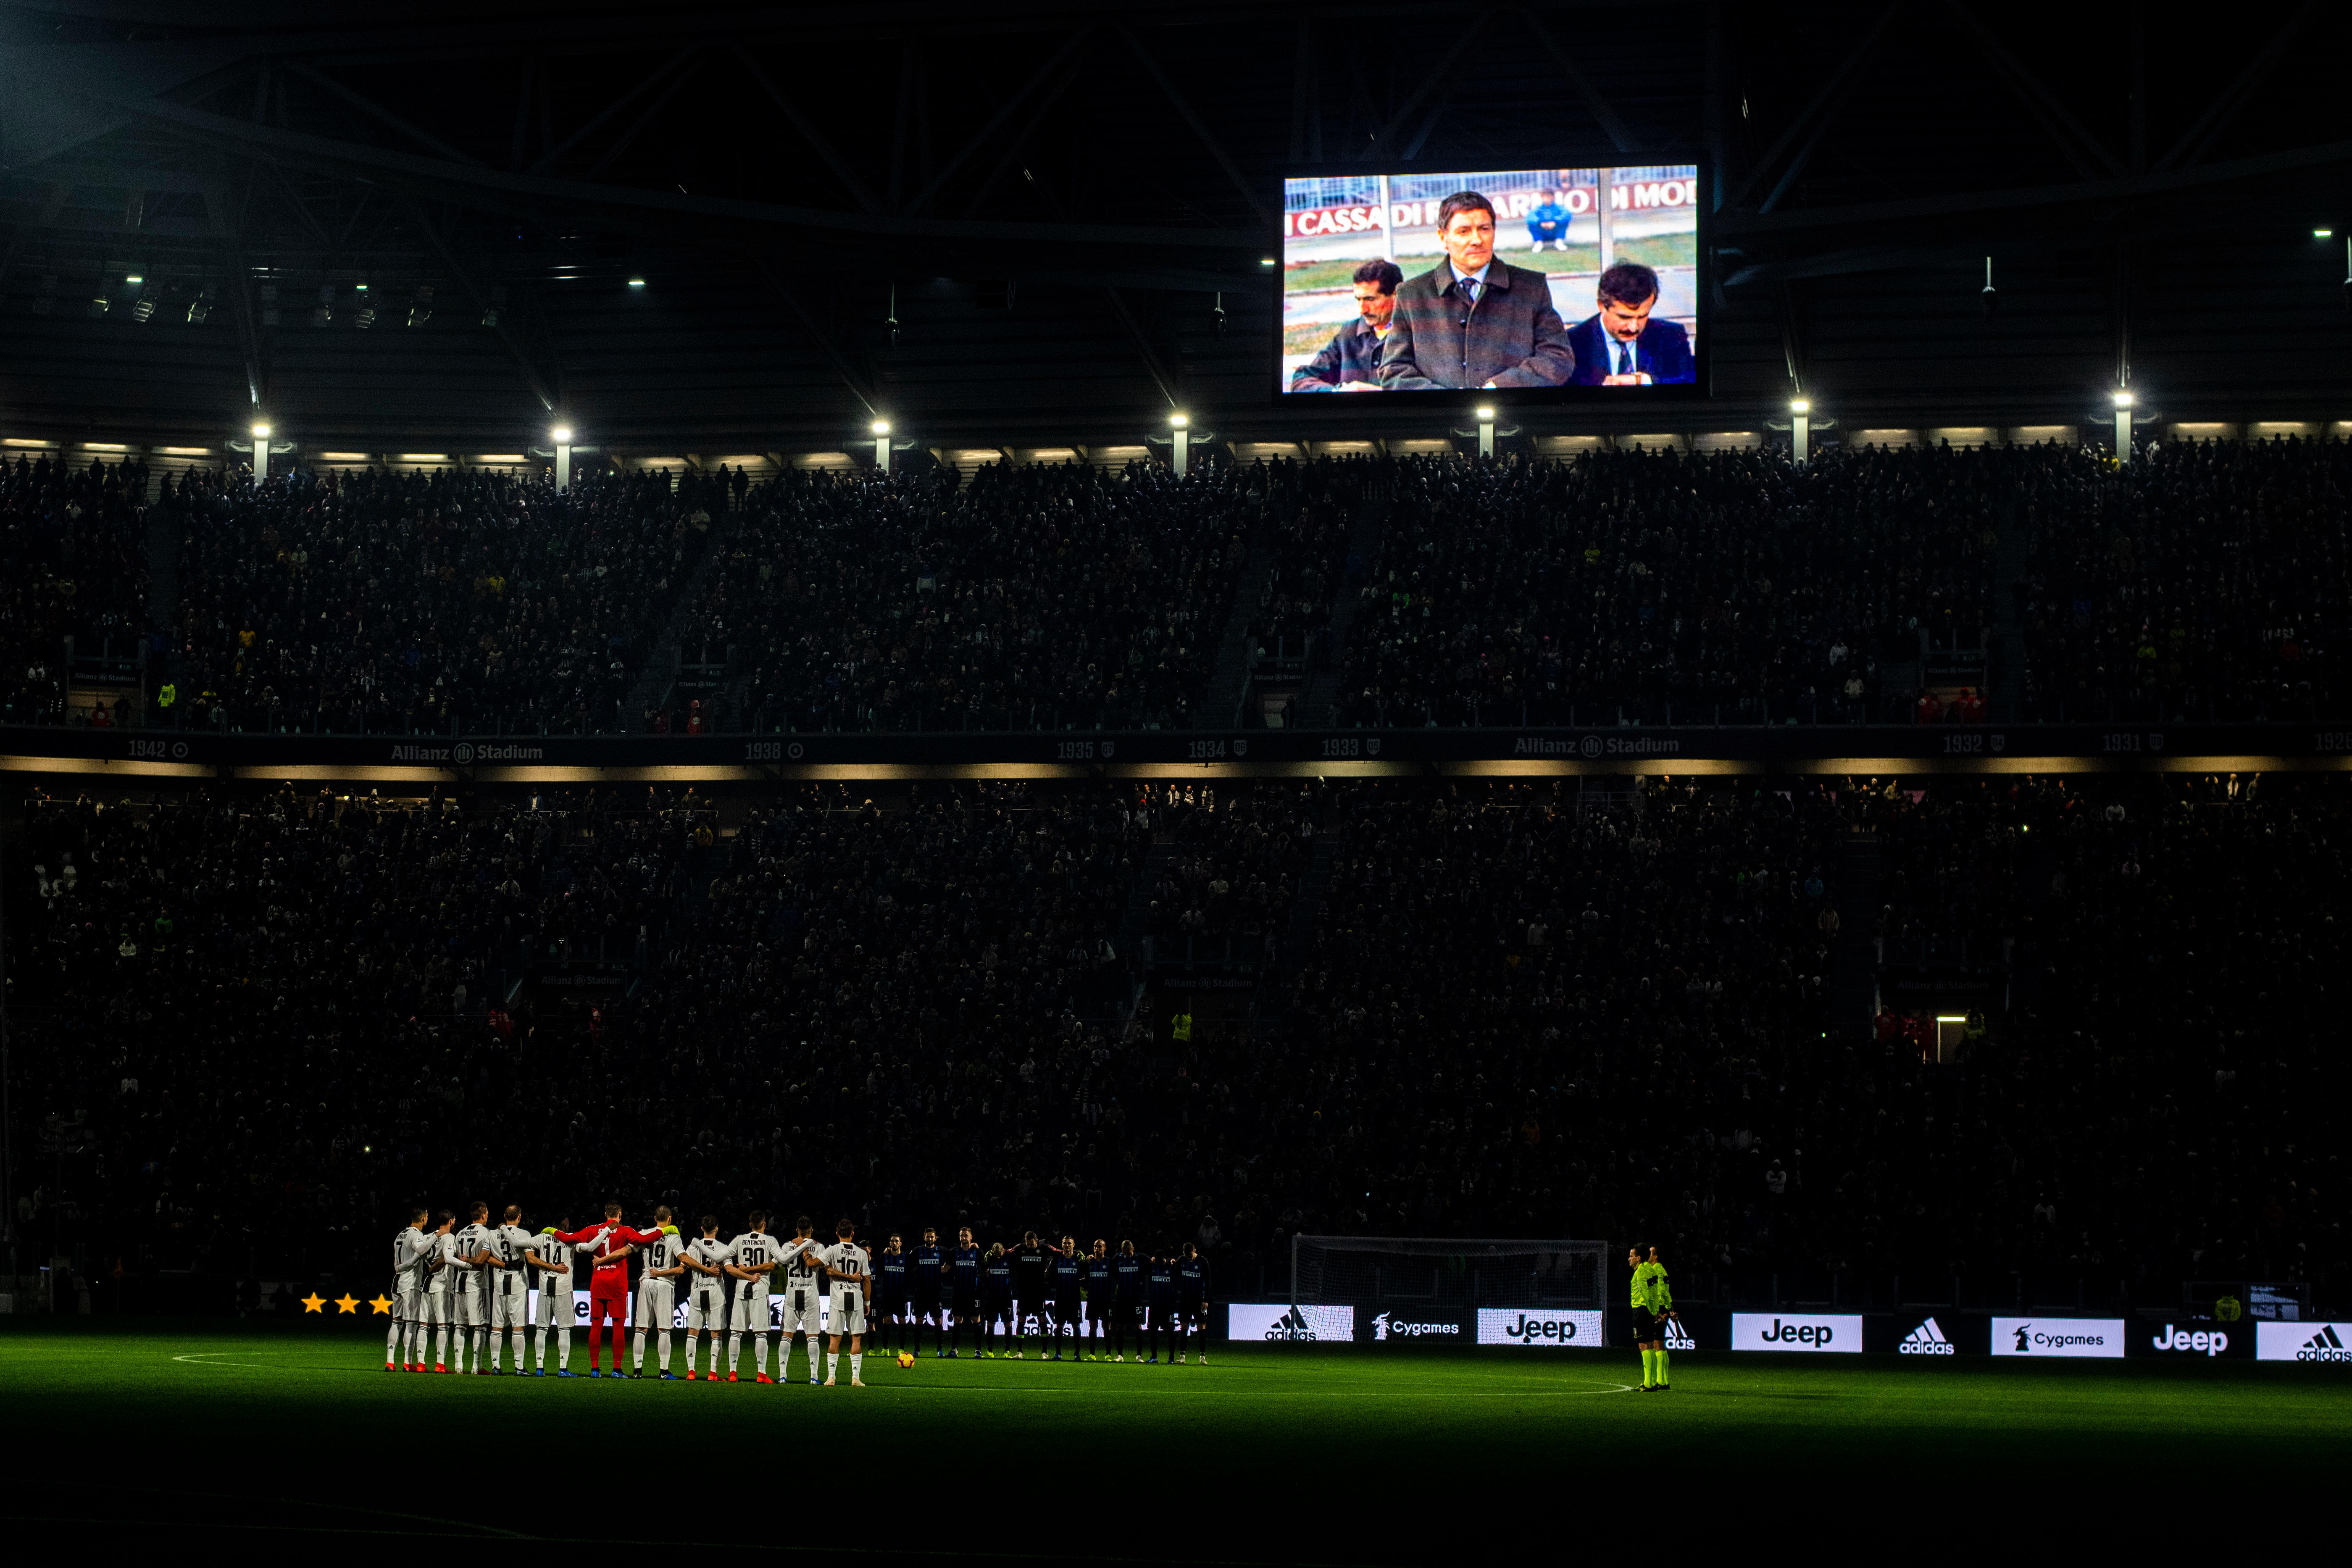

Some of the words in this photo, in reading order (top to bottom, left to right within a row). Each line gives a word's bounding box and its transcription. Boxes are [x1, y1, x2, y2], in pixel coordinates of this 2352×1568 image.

[1298, 206, 1382, 235] CASSA
[1392, 203, 1421, 227] DI
[128, 739, 165, 757] 1942
[745, 742, 781, 760] 1938
[1058, 742, 1093, 759] 1935
[1189, 740, 1226, 758] 1934
[1322, 738, 1359, 756] 1933
[1514, 737, 1576, 754] Allianz
[1607, 737, 1679, 753] Stadium
[1943, 734, 1983, 753] 1932
[2102, 733, 2142, 752] 1931
[391, 745, 450, 760] Allianz
[477, 745, 543, 759] Stadium
[542, 975, 572, 985] Allianz
[1164, 978, 1197, 988] Allianz
[1213, 978, 1252, 988] Stadium
[396, 1242, 403, 1264] 7
[458, 1238, 476, 1259] 17
[544, 1243, 561, 1266] 14
[645, 1243, 666, 1268] 19
[743, 1247, 764, 1268] 30
[837, 1257, 858, 1283] 10
[1392, 1321, 1459, 1336] Cygames
[1506, 1314, 1576, 1343] Jeep
[1762, 1319, 1833, 1348] Jeep
[1899, 1341, 1955, 1355] adidas
[2034, 1333, 2104, 1348] Cygames
[2153, 1324, 2228, 1356] Jeep
[2297, 1348, 2352, 1362] adidas
